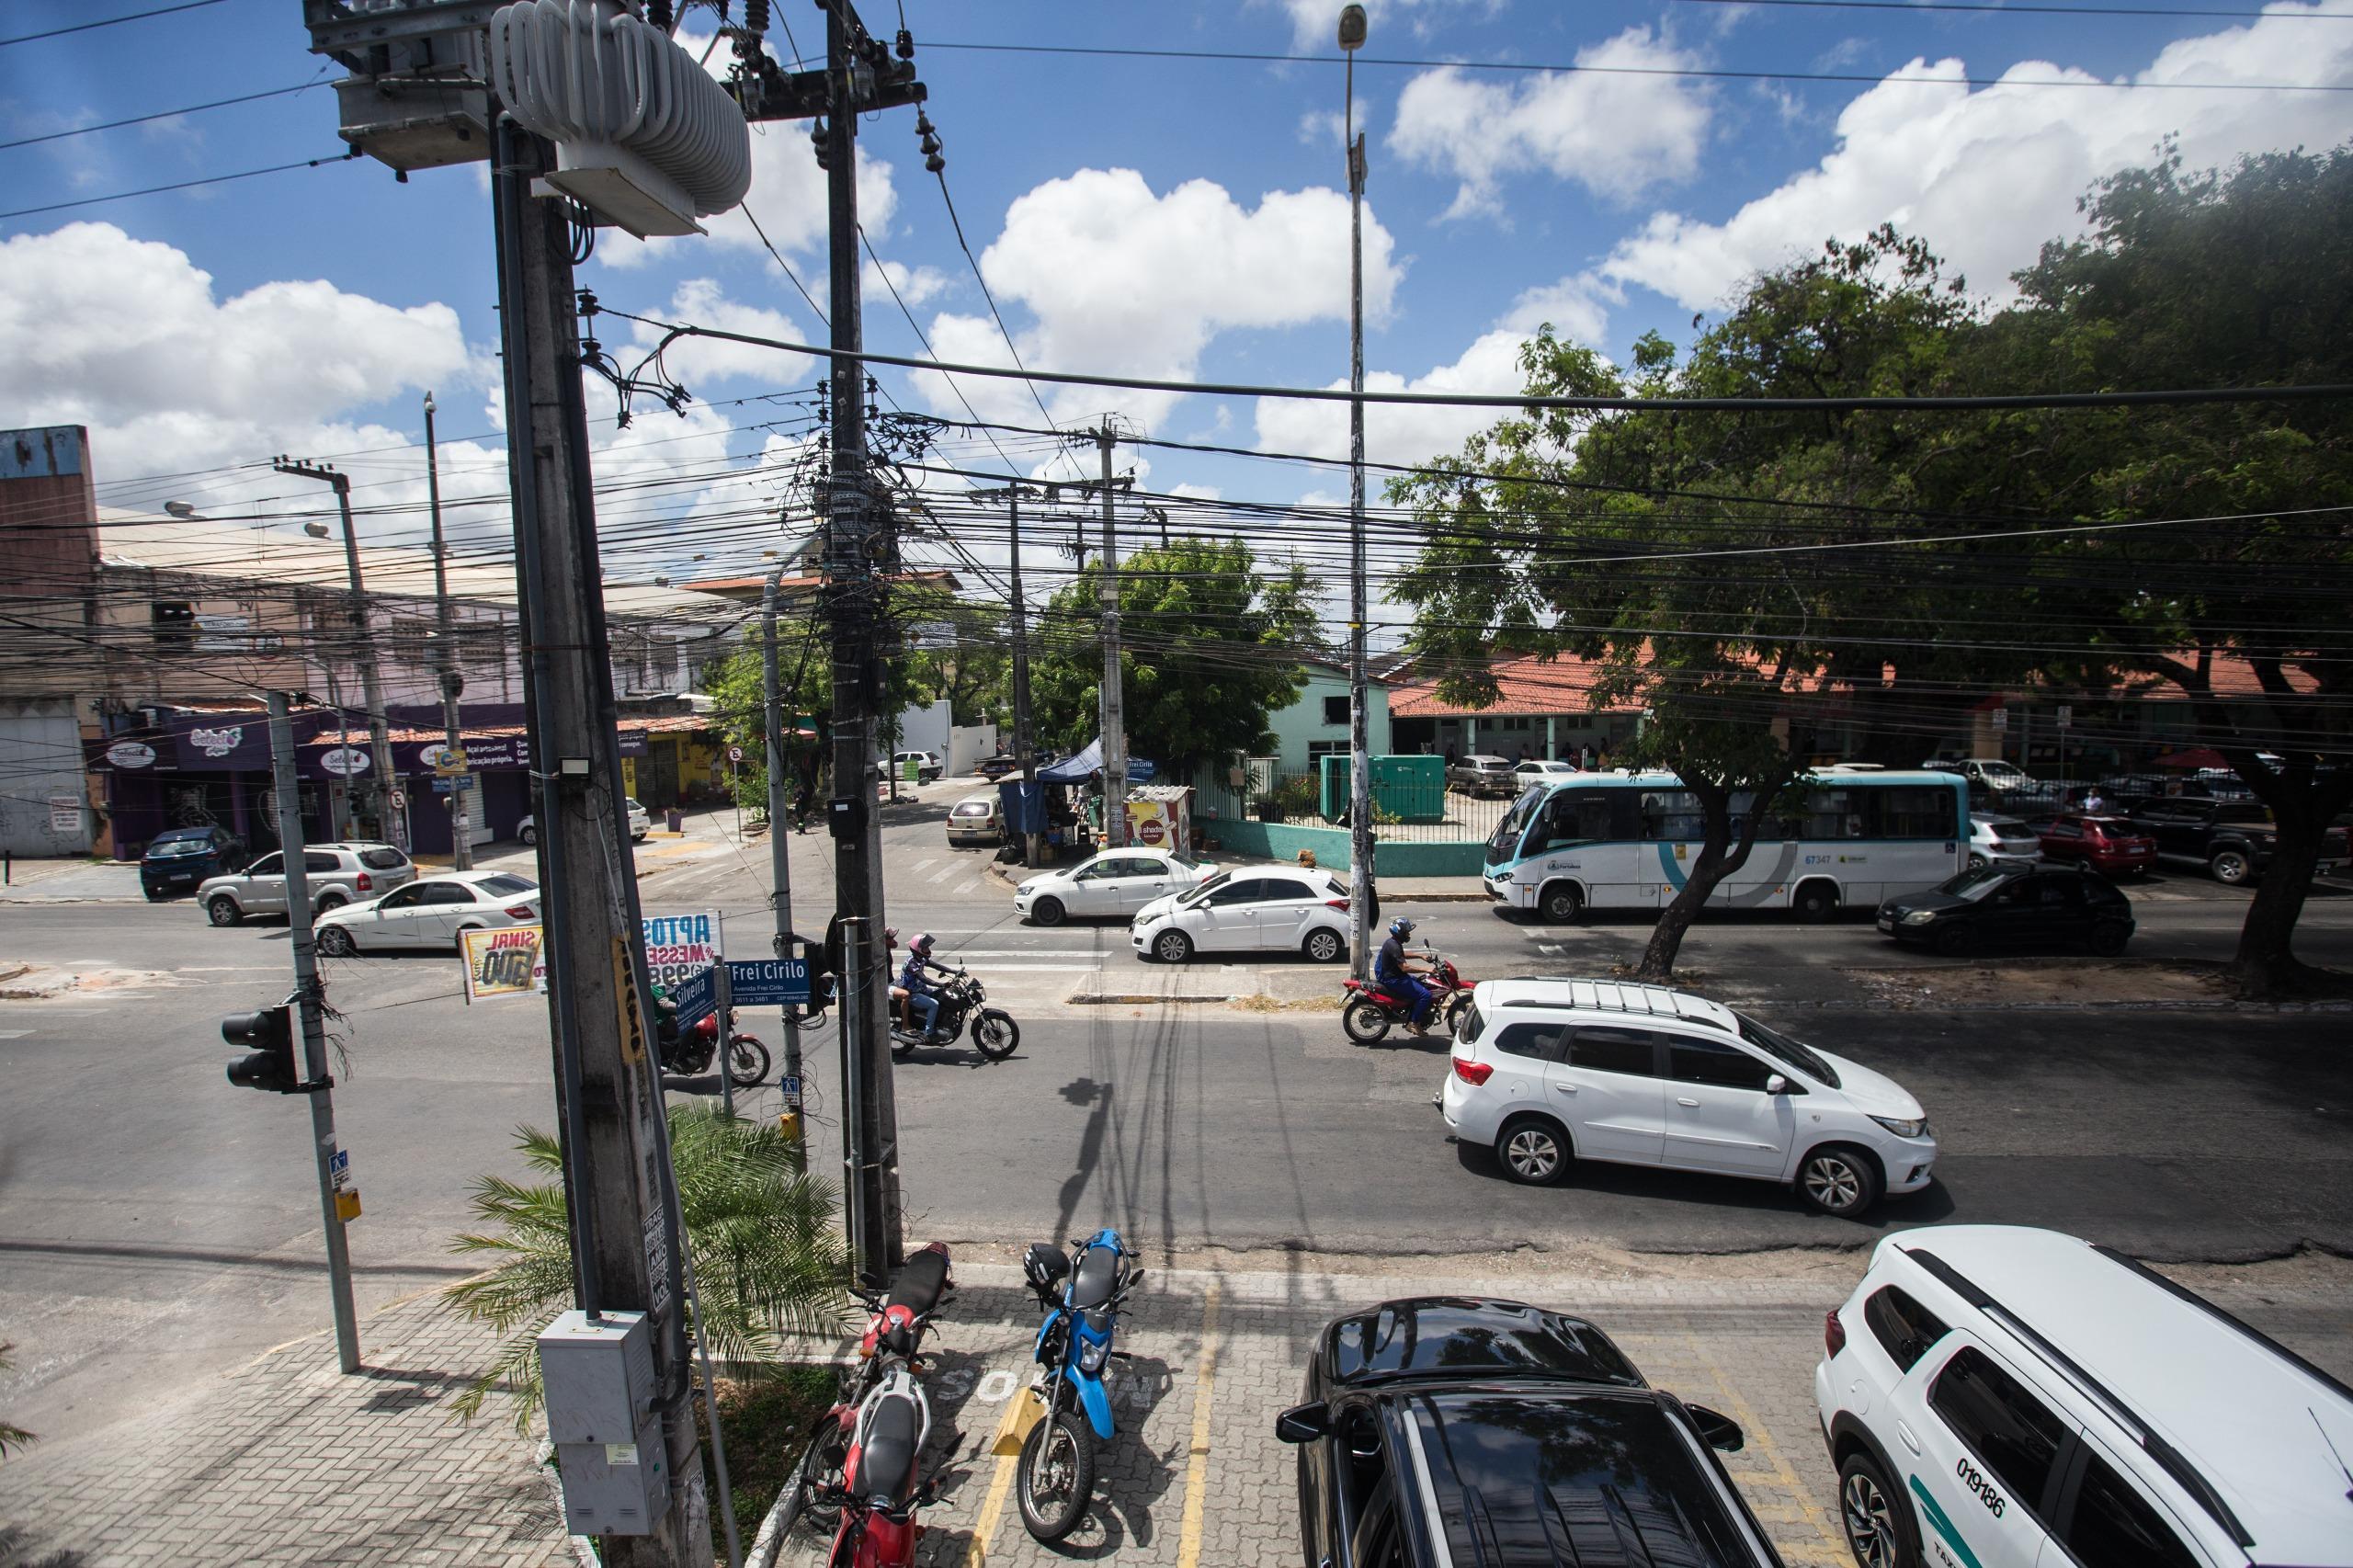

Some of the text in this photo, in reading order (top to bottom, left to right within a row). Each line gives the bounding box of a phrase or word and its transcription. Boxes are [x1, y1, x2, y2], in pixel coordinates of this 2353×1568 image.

[733, 961, 805, 981] Frei Cirilo
[676, 978, 705, 1007] Silveira
[644, 1207, 664, 1233] TRAG
[1956, 1458, 2006, 1519] 019186
